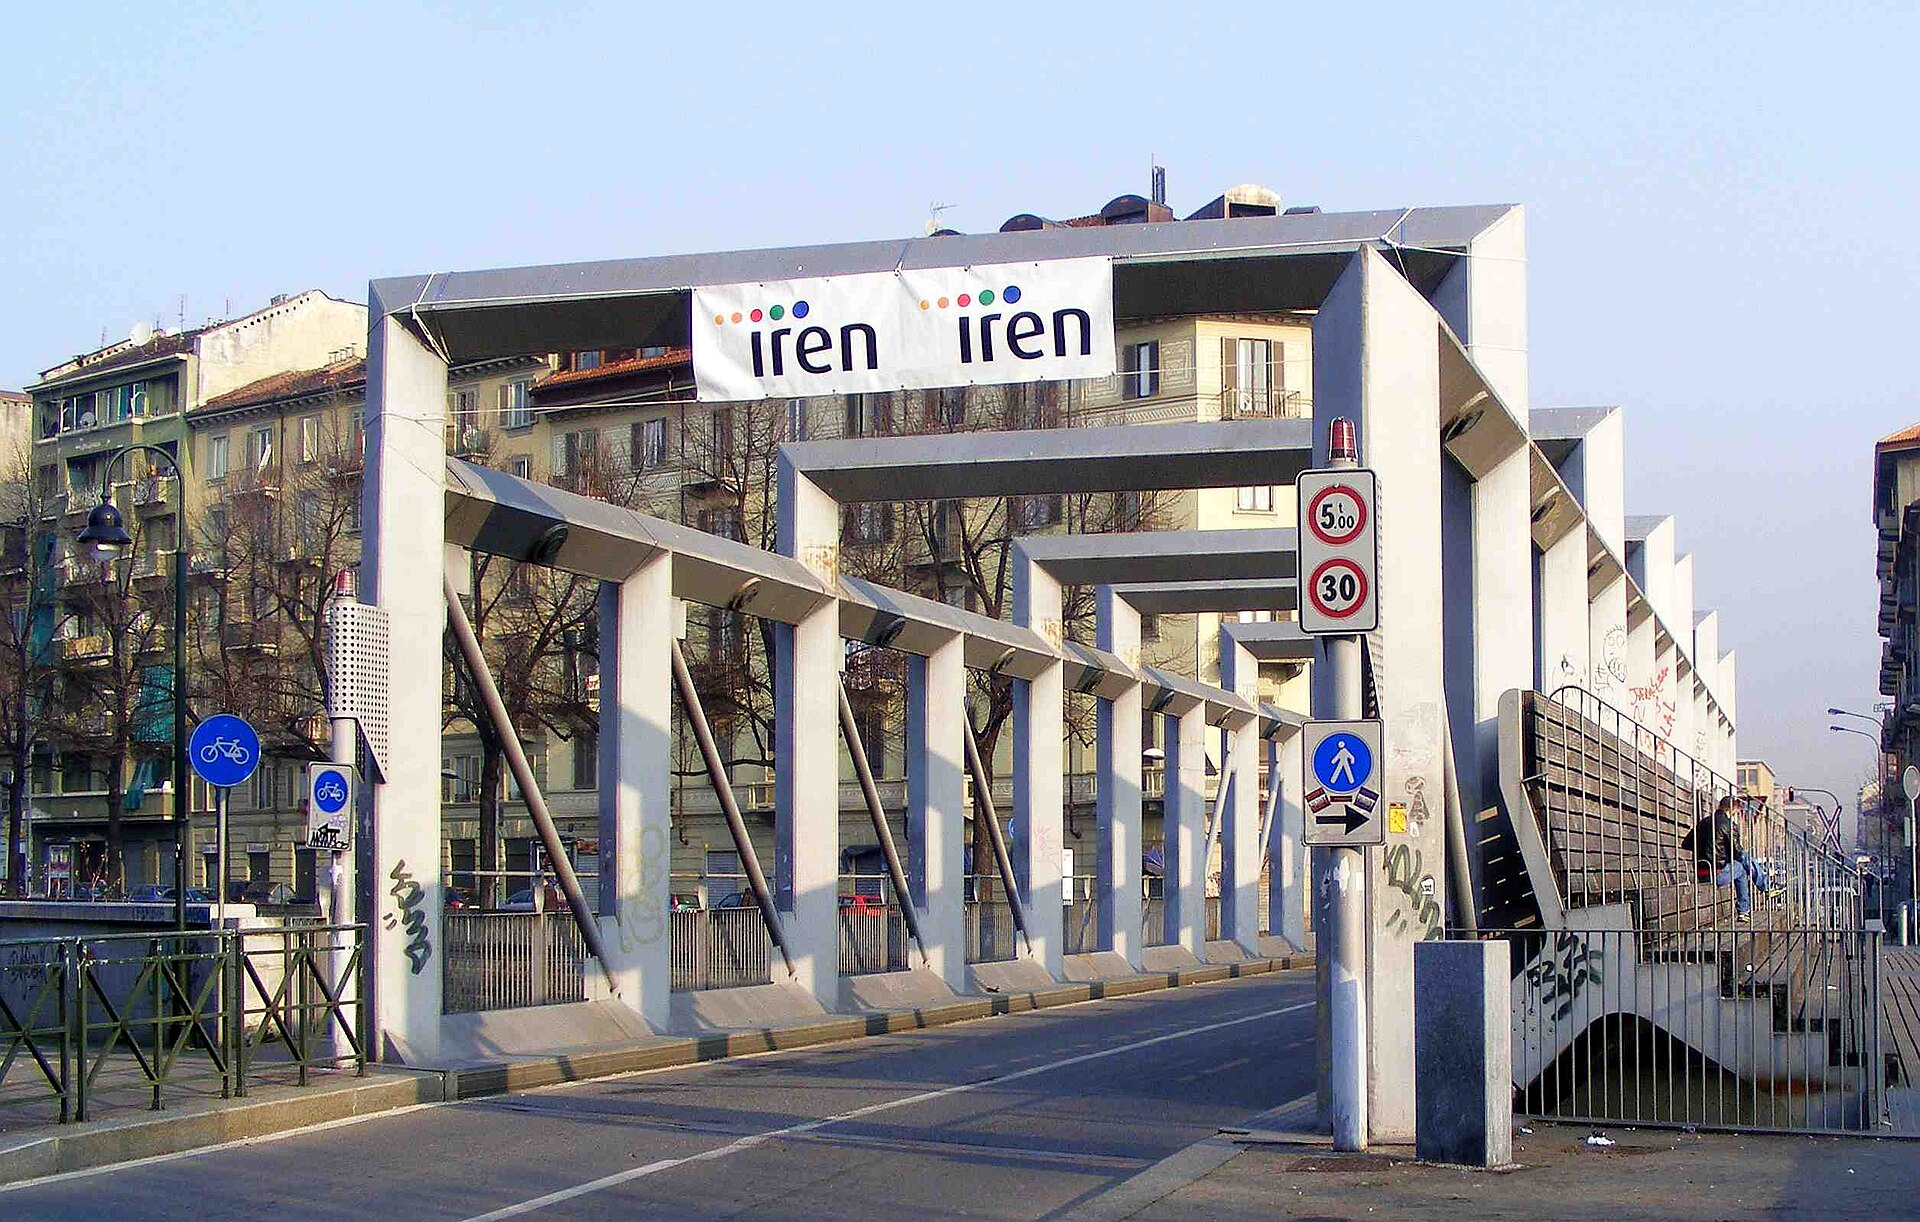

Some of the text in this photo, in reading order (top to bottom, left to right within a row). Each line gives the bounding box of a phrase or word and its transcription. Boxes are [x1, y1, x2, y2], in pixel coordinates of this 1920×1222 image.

[751, 308, 1091, 377] iren iren
[1322, 574, 1356, 602] 30
